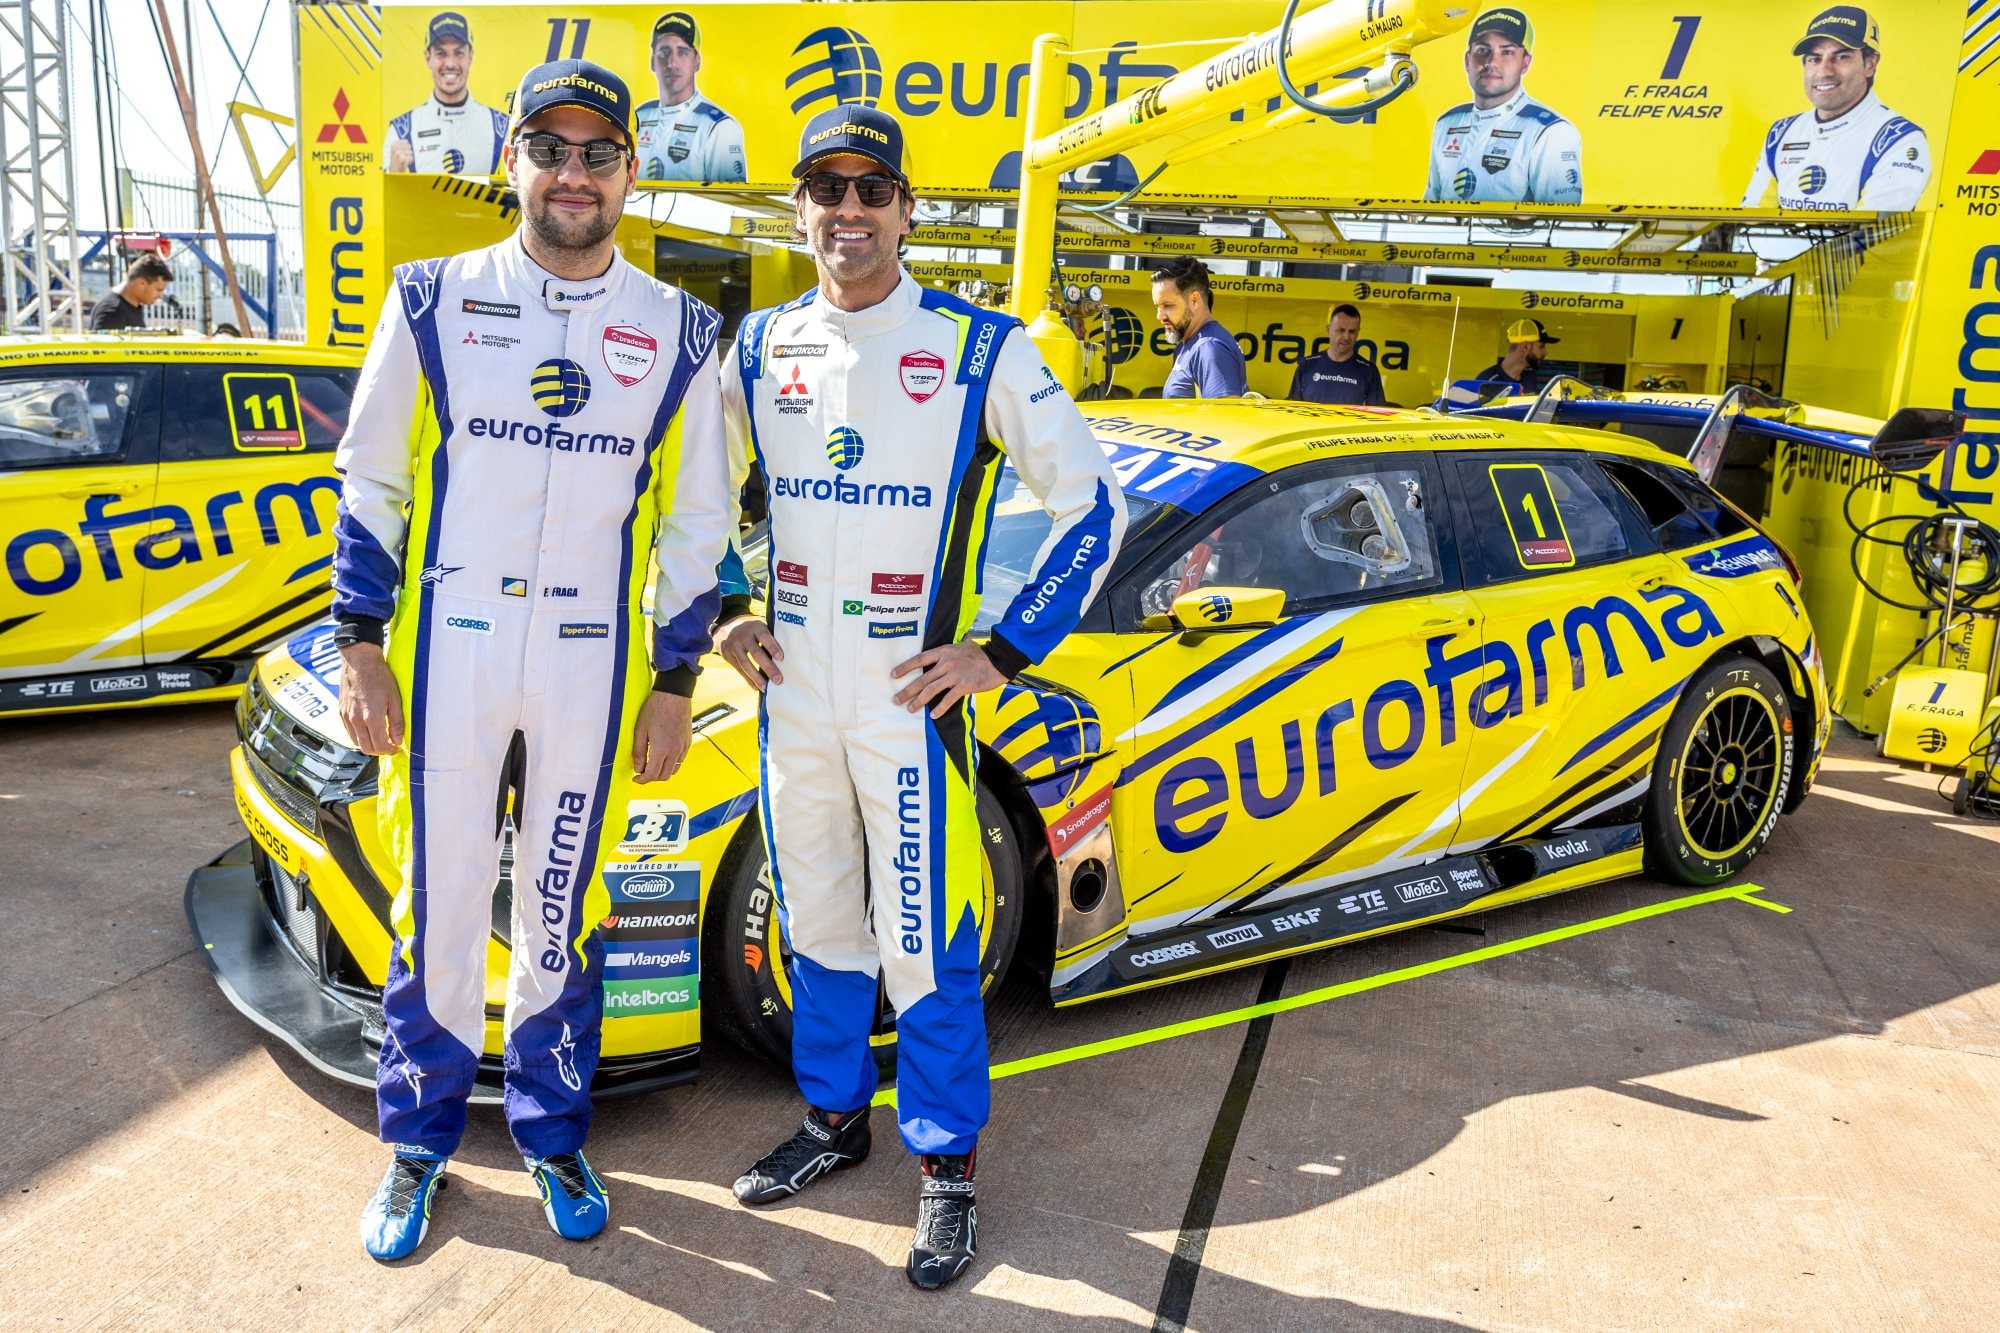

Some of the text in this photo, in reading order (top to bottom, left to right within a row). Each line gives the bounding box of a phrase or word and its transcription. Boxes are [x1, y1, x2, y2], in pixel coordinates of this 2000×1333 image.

[1360, 29, 1369, 42] G.
[1376, 15, 1404, 36] MAURO
[1810, 16, 1857, 30] eurofarma
[543, 17, 591, 65] 11
[1660, 16, 1702, 79] 1
[533, 74, 618, 104] eurofarma
[1625, 85, 1708, 99] F. FRAGA
[1599, 104, 1723, 119] FELIPE NASR
[809, 121, 889, 145] eurofarma
[312, 151, 373, 163] MITSUBISHI
[320, 165, 365, 176] MOTORS
[1892, 162, 1925, 174] eurofarma
[1957, 185, 2000, 198] MITS
[1062, 234, 1131, 250] eurofarma
[1153, 241, 1196, 251] REHIDRAT
[1226, 241, 1299, 256] eurofarma
[1322, 247, 1368, 258] REHIDRAT
[1398, 247, 1475, 261] eurofarma
[1500, 254, 1548, 264] REHIDRAT
[1582, 254, 1661, 268] eurofarma
[1688, 259, 1738, 269] REHIDRAT
[566, 287, 606, 302] eurofarma
[914, 264, 1625, 310] eurofarma eurofarma eurofarma eurofarma eurofarma
[1670, 318, 1684, 341] 1
[481, 341, 511, 350] MOTORS
[482, 333, 521, 345] MITSUBISHI
[619, 335, 650, 349] bradesco
[968, 322, 997, 379] sparco
[913, 360, 939, 368] bradesco
[1320, 374, 1358, 386] eurofarma
[1029, 380, 1065, 404] eurofa
[774, 398, 814, 407] MITSUBISHI
[778, 406, 808, 415] MOTORS
[244, 394, 288, 430] 11
[468, 417, 636, 457] eurofarma
[1310, 437, 1345, 450] FELIPE
[1349, 435, 1381, 445] FRAGA
[1433, 432, 1466, 442] FELIPE
[1467, 431, 1493, 441] NASR
[775, 474, 933, 508] eurofarma
[1521, 492, 1547, 539] 1
[1714, 548, 1776, 572] REHIDRAT
[543, 587, 578, 598] F. FRAGA
[777, 589, 808, 607] sparco
[863, 605, 921, 615] Felipe Nasr
[447, 617, 492, 632] COBREQ
[562, 626, 607, 636] Hipper Freios
[872, 625, 914, 636] Hipper Freios
[96, 677, 142, 691] MoTeC
[157, 671, 192, 682] Hipper
[160, 680, 192, 689] Freios
[48, 681, 76, 694] TE
[1927, 681, 1950, 704] 1
[1906, 703, 1966, 719] F. FRAGA
[1153, 585, 1726, 855] eurofarma
[1066, 795, 1111, 835] Snapdragon
[624, 814, 683, 842] CBA
[254, 816, 289, 864] CROSS
[1544, 840, 1589, 860] Kevlar
[616, 863, 663, 871] POWERED
[893, 767, 923, 955] eurofarma
[535, 790, 587, 973] erofarma
[1449, 867, 1478, 883] Hipper
[628, 879, 667, 894] podium
[1402, 879, 1442, 901] MoTeC
[1457, 878, 1484, 893] Freios
[1359, 889, 1387, 910] TE
[1271, 908, 1322, 933] SKF
[1213, 927, 1258, 947] MOTUL
[630, 949, 691, 968] Mangels
[1130, 943, 1200, 967] COBREQ
[605, 989, 690, 1008] intelbras
